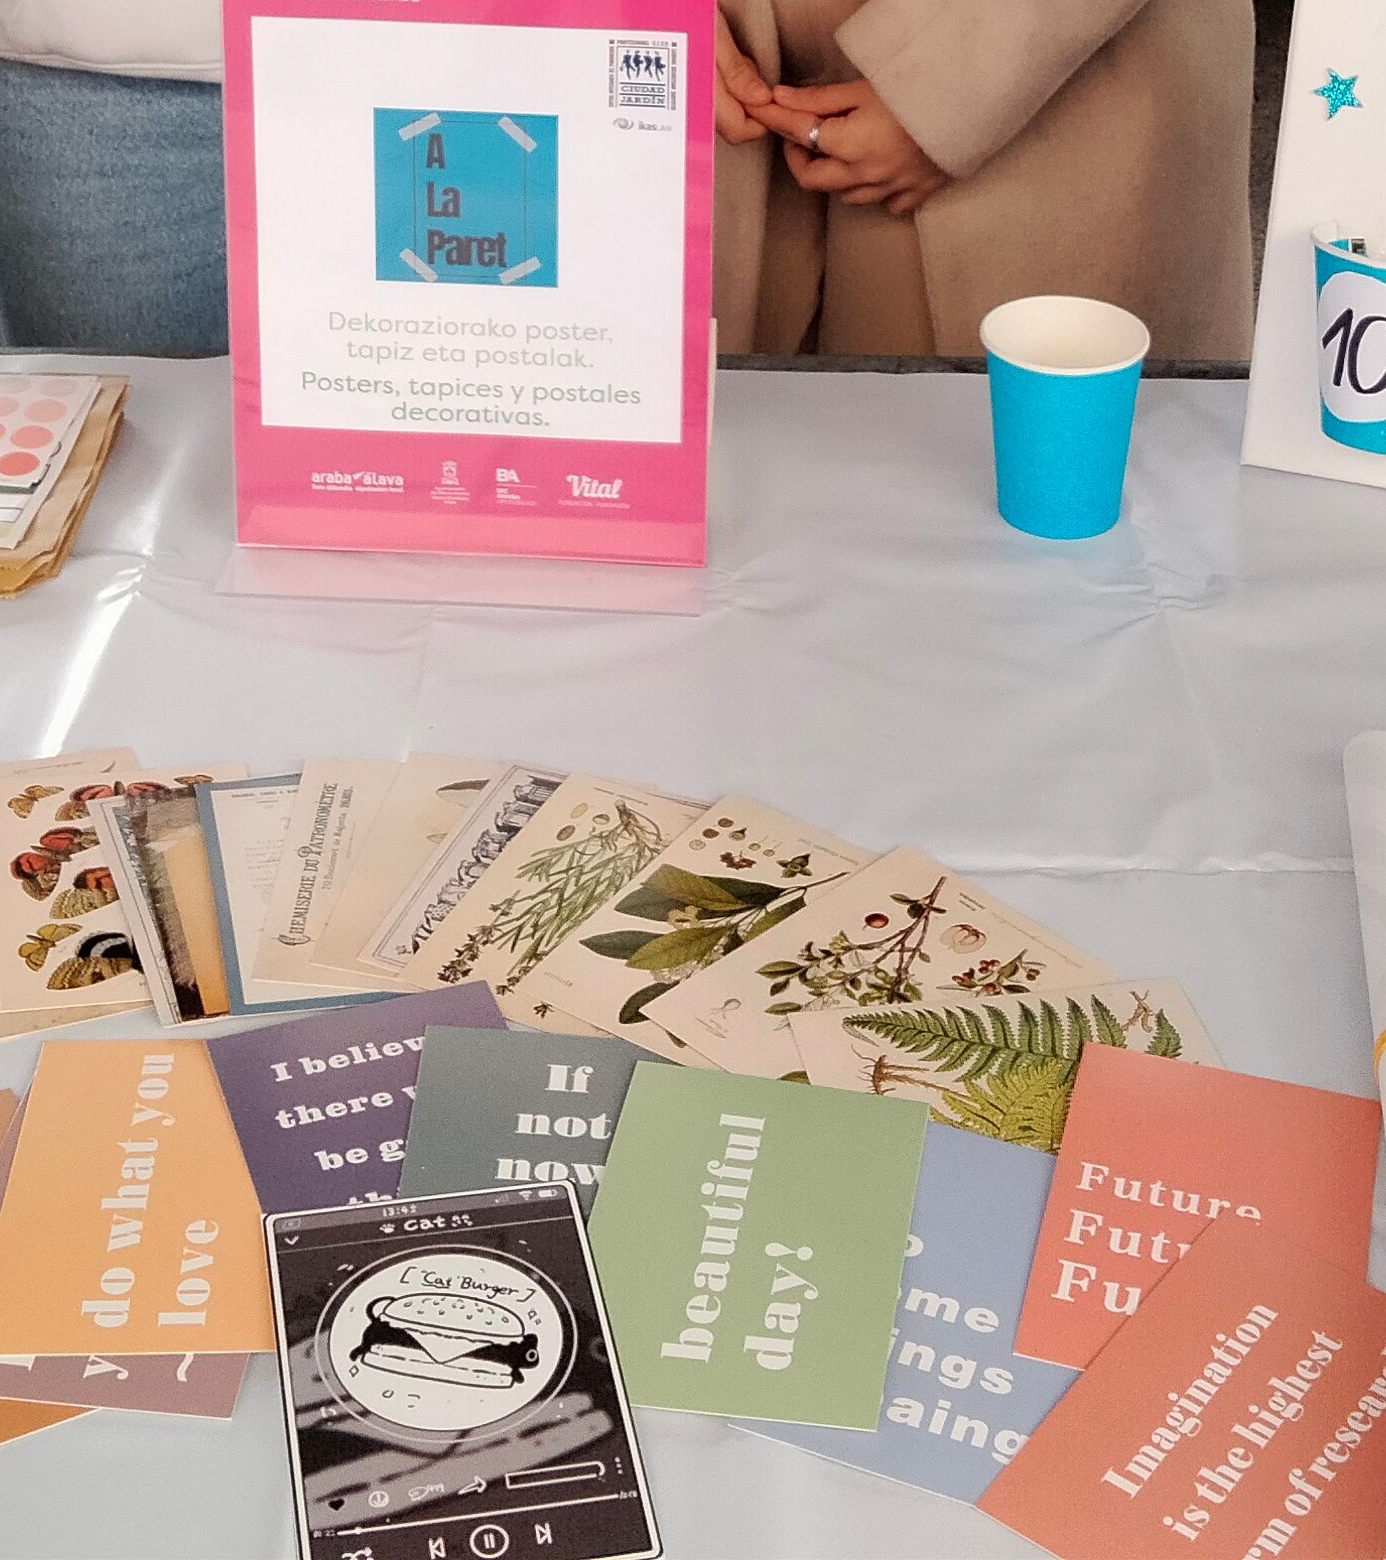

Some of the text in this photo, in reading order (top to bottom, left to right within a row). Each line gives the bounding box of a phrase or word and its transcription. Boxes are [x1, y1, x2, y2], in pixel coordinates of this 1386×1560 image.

[620, 85, 665, 94] CIUDAD
[426, 132, 446, 169] A
[426, 181, 461, 218] La
[426, 229, 507, 268] Paret
[328, 311, 614, 345] Dekoraziorako poster,
[346, 340, 595, 369] tapiz eta postalak.
[301, 371, 642, 406] Posters, tapices y postales
[391, 401, 550, 427] decorativas.
[311, 471, 352, 485] araba
[566, 474, 623, 499] Vital
[270, 1062, 293, 1082] I
[544, 1063, 596, 1095] If
[274, 1092, 394, 1129] there
[515, 1110, 612, 1141] not
[313, 1147, 369, 1171] be
[81, 1052, 176, 1328] do what you
[659, 1113, 766, 1364] beautiful
[157, 1218, 219, 1327] love
[743, 1241, 821, 1371] day!
[898, 1287, 999, 1334] me
[1099, 1303, 1280, 1501] Imagination
[1162, 1329, 1345, 1543] is the highest
[1284, 1466, 1324, 1518] of
